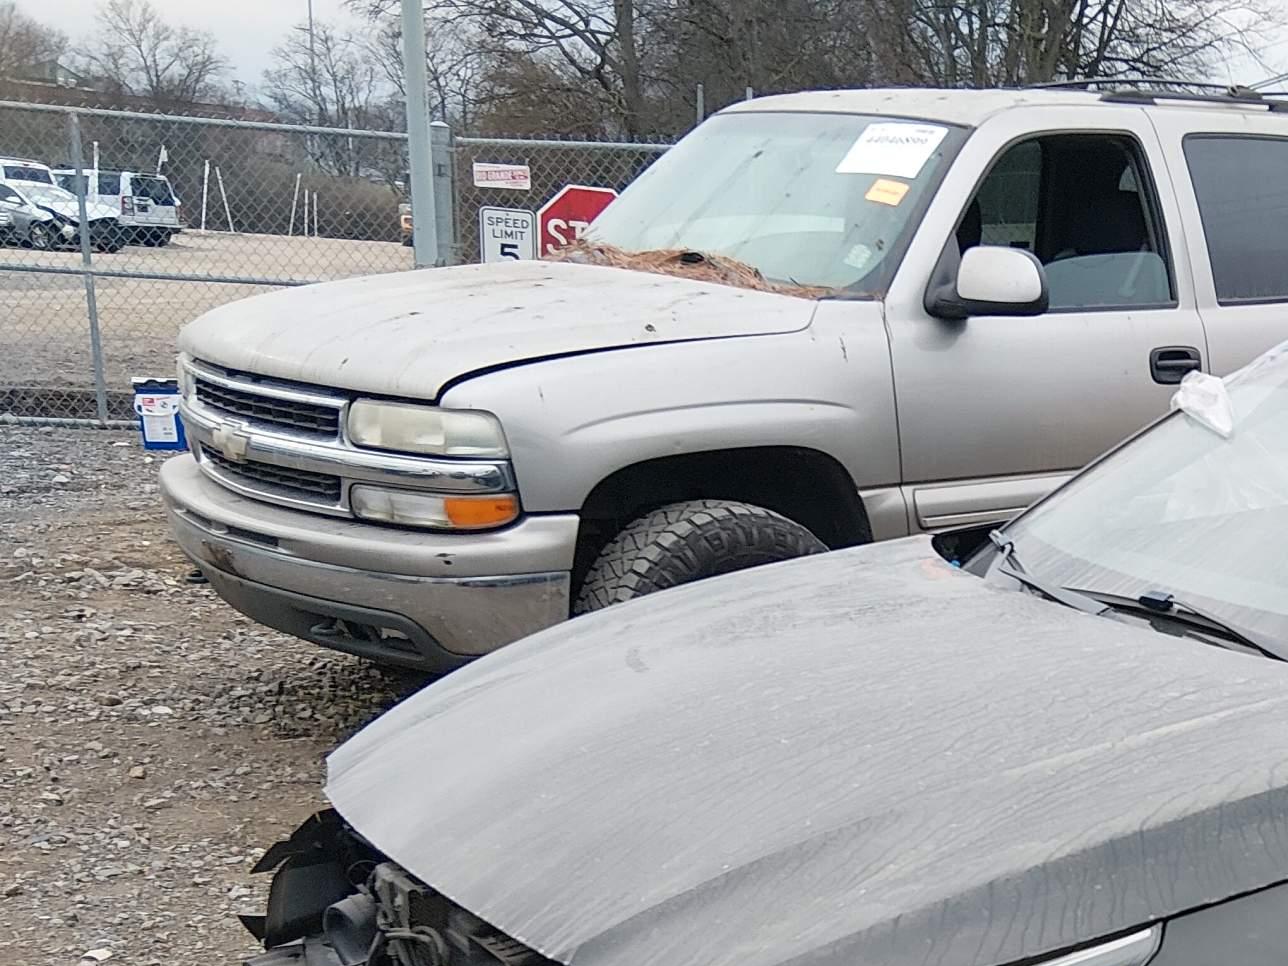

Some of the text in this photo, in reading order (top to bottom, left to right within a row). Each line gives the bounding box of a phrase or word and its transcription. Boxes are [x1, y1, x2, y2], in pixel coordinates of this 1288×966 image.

[487, 216, 529, 229] SPEED
[492, 229, 525, 241] LIMIT
[546, 218, 590, 255] ST
[500, 243, 519, 260] 5
